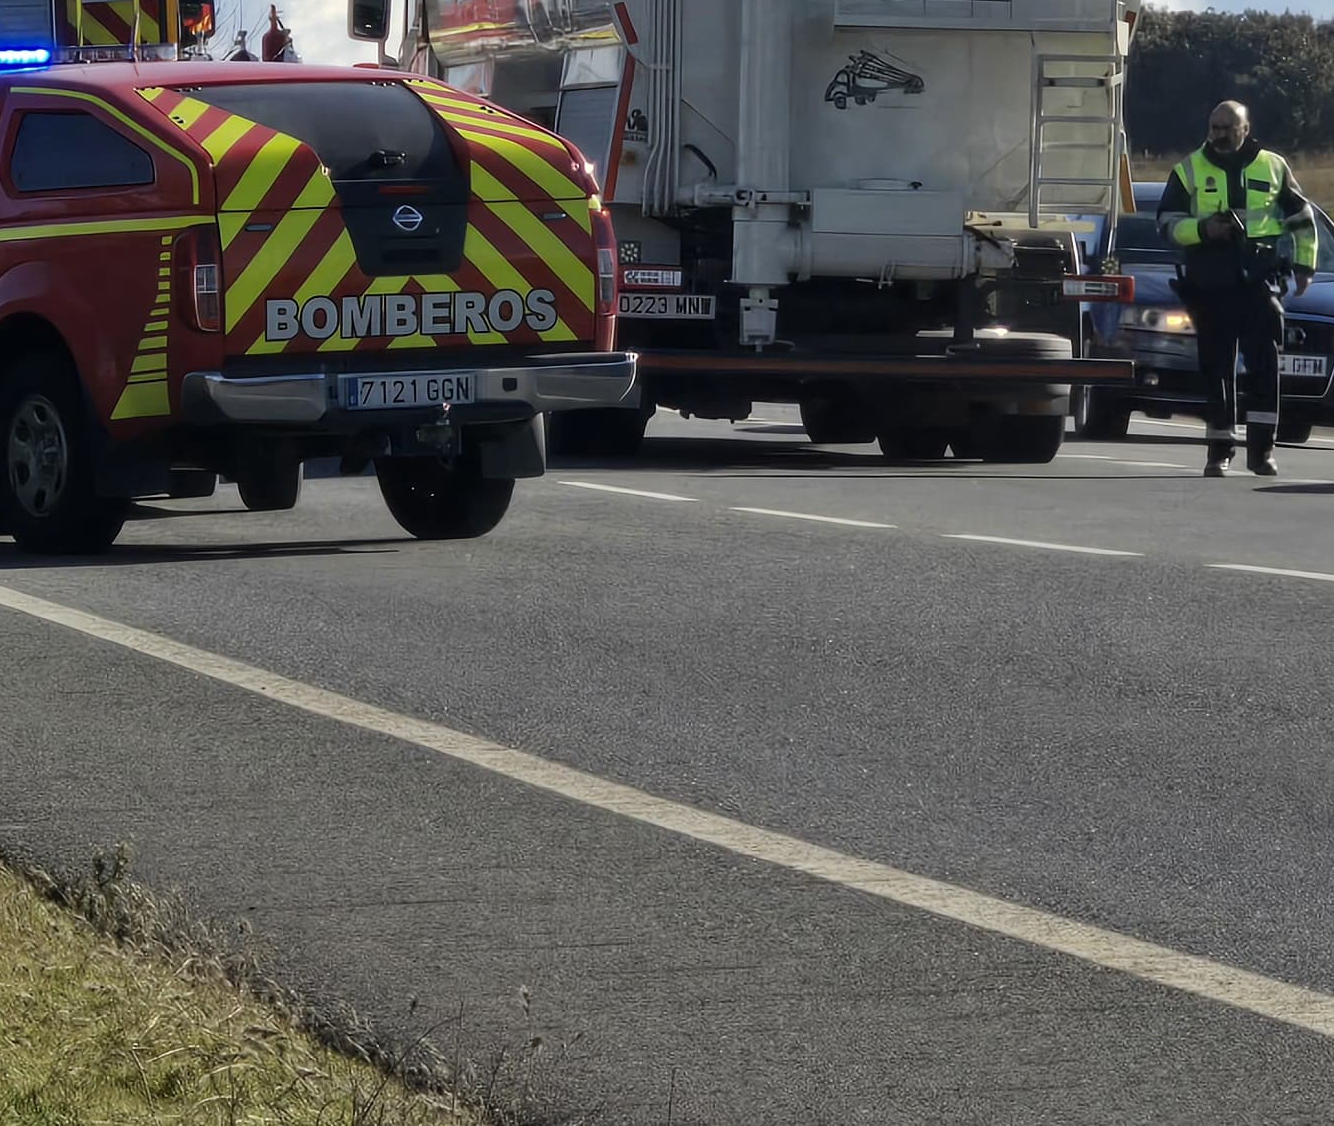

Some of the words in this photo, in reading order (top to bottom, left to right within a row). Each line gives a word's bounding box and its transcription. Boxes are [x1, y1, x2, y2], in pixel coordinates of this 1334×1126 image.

[265, 287, 558, 342] BOMBEROS
[619, 296, 668, 315] 0223
[360, 379, 418, 405] 7121
[427, 377, 469, 401] GGN
